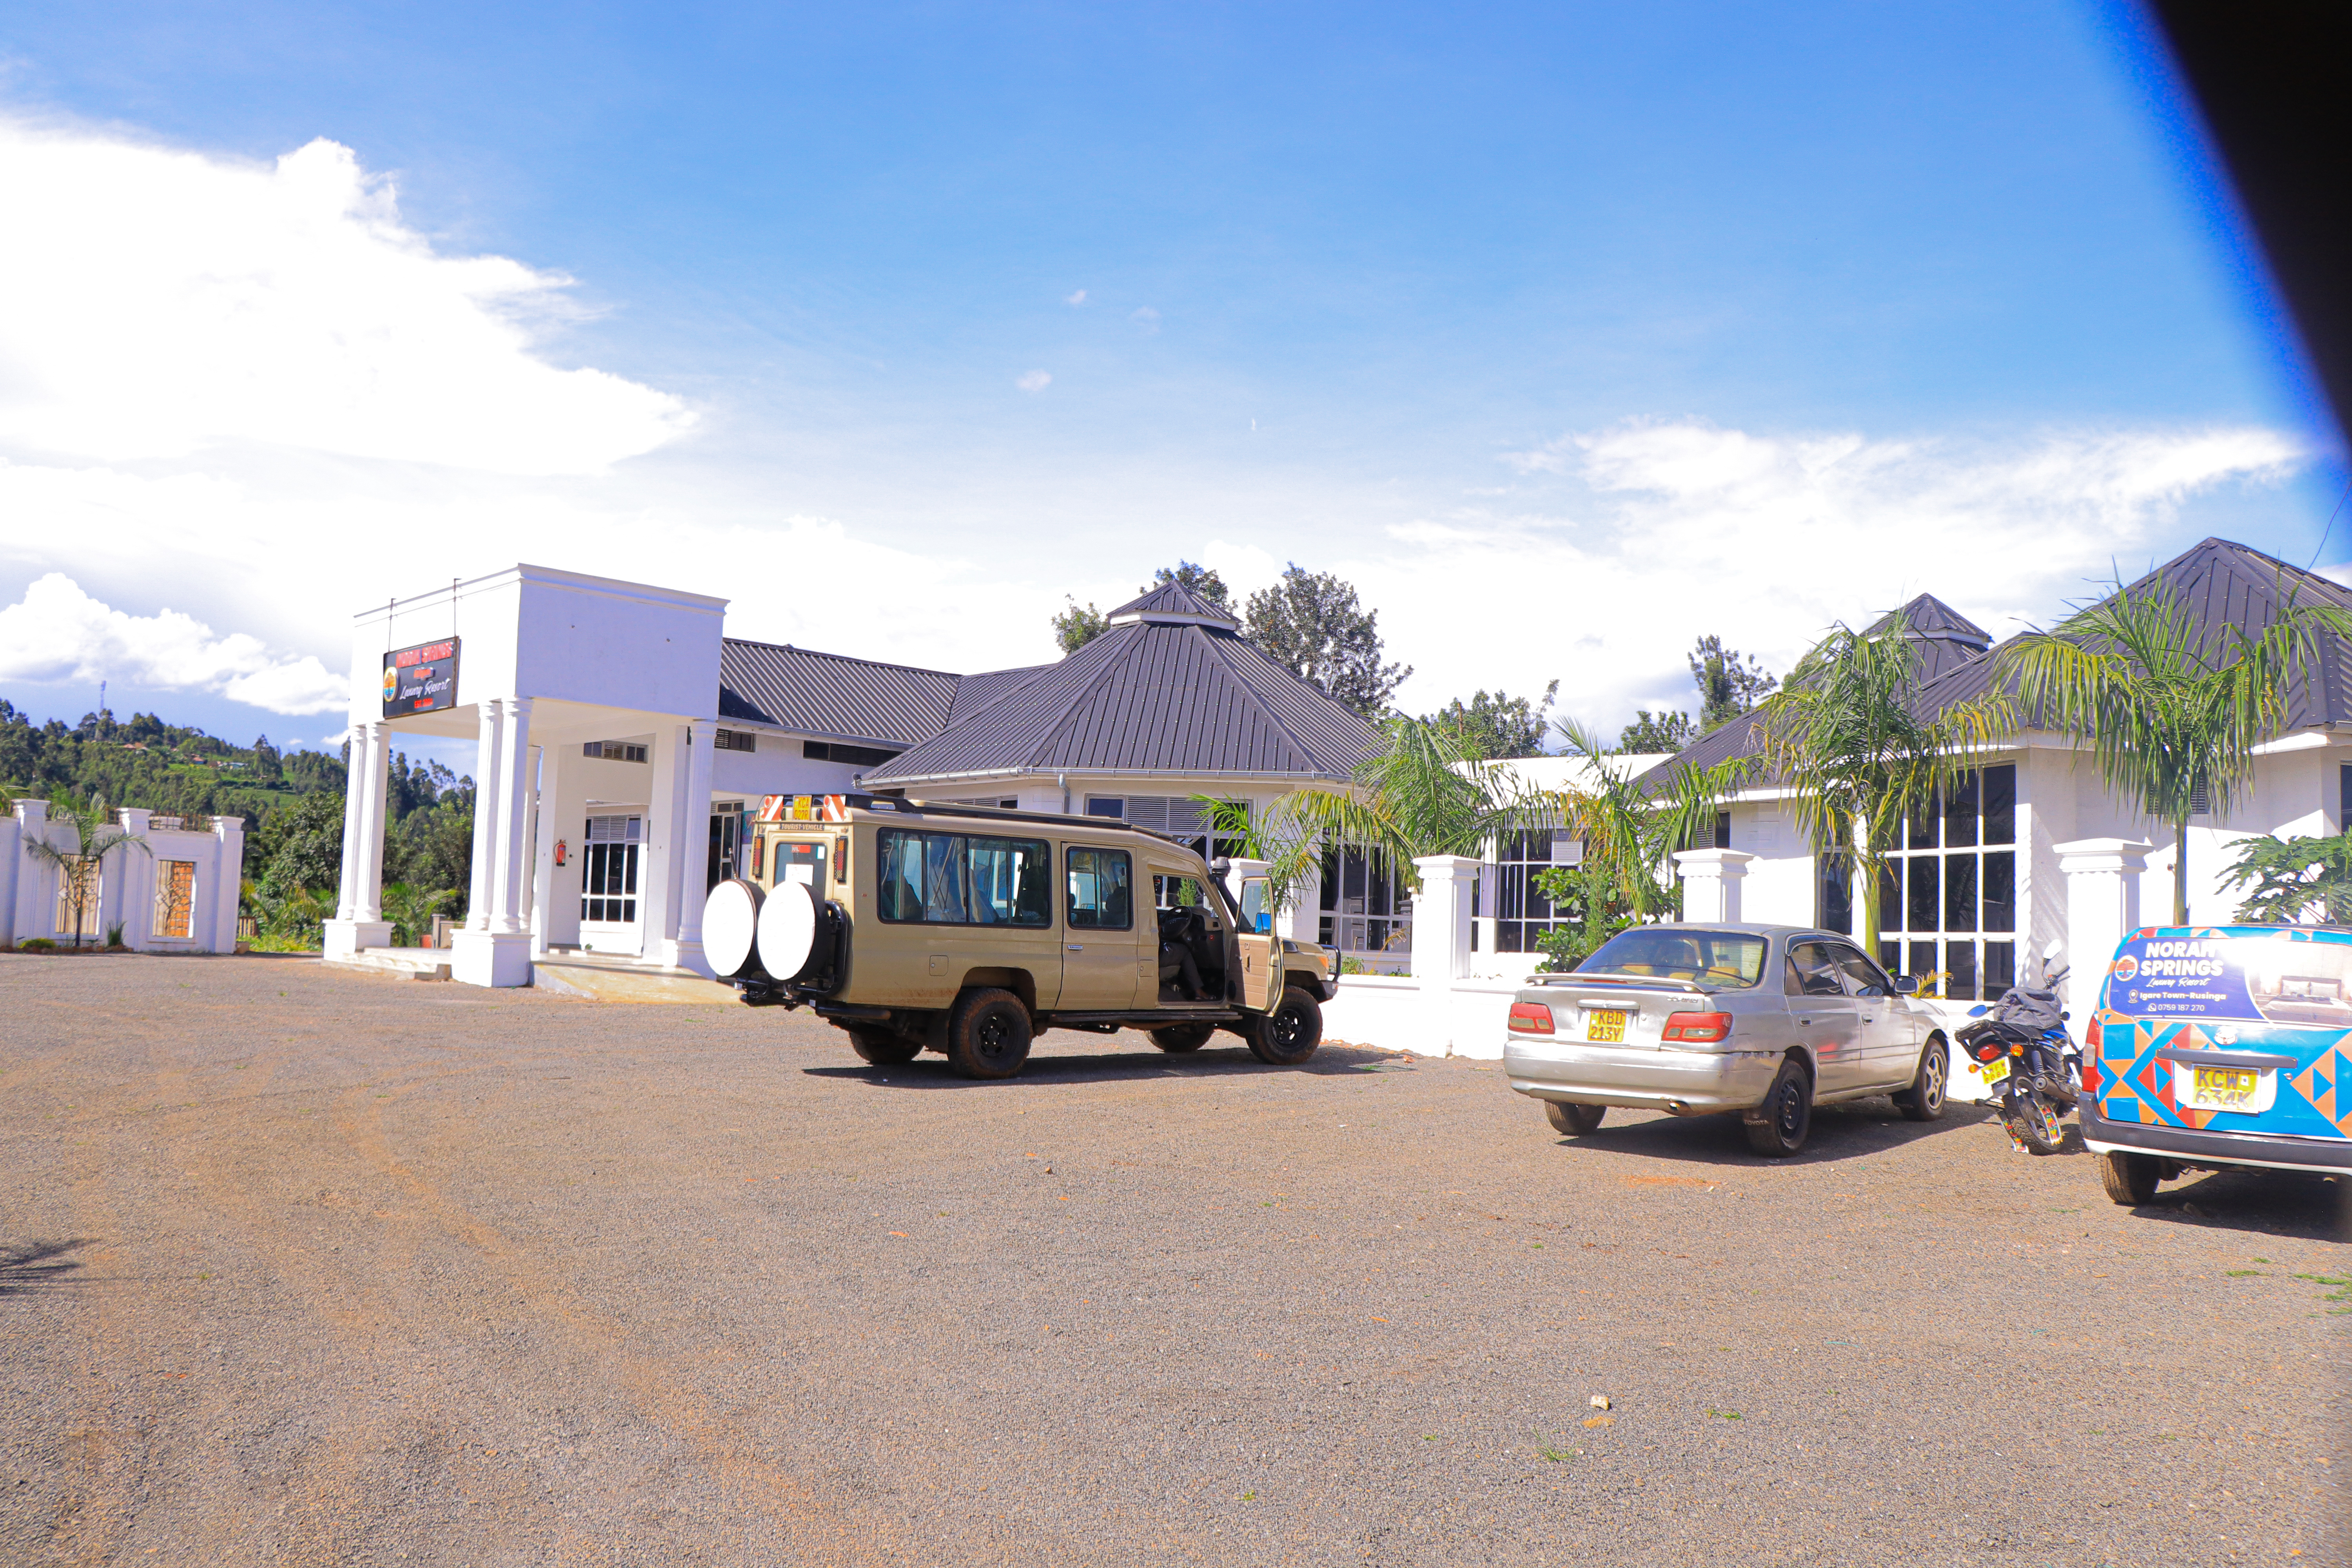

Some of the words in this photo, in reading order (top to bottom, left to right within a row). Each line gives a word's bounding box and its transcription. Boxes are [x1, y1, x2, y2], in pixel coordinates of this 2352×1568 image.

[798, 797, 809, 808] KCA
[2145, 942, 2216, 958] NORAH
[2140, 960, 2223, 976] SPRINGS
[2146, 977, 2176, 987] Luxury
[2178, 977, 2212, 987] Resort
[2140, 993, 2161, 1001] Igare
[1598, 1011, 1623, 1025] KBD
[1590, 1026, 1621, 1041] 213Y
[2197, 1068, 2239, 1090] KCW
[2195, 1087, 2251, 1108] 634K
